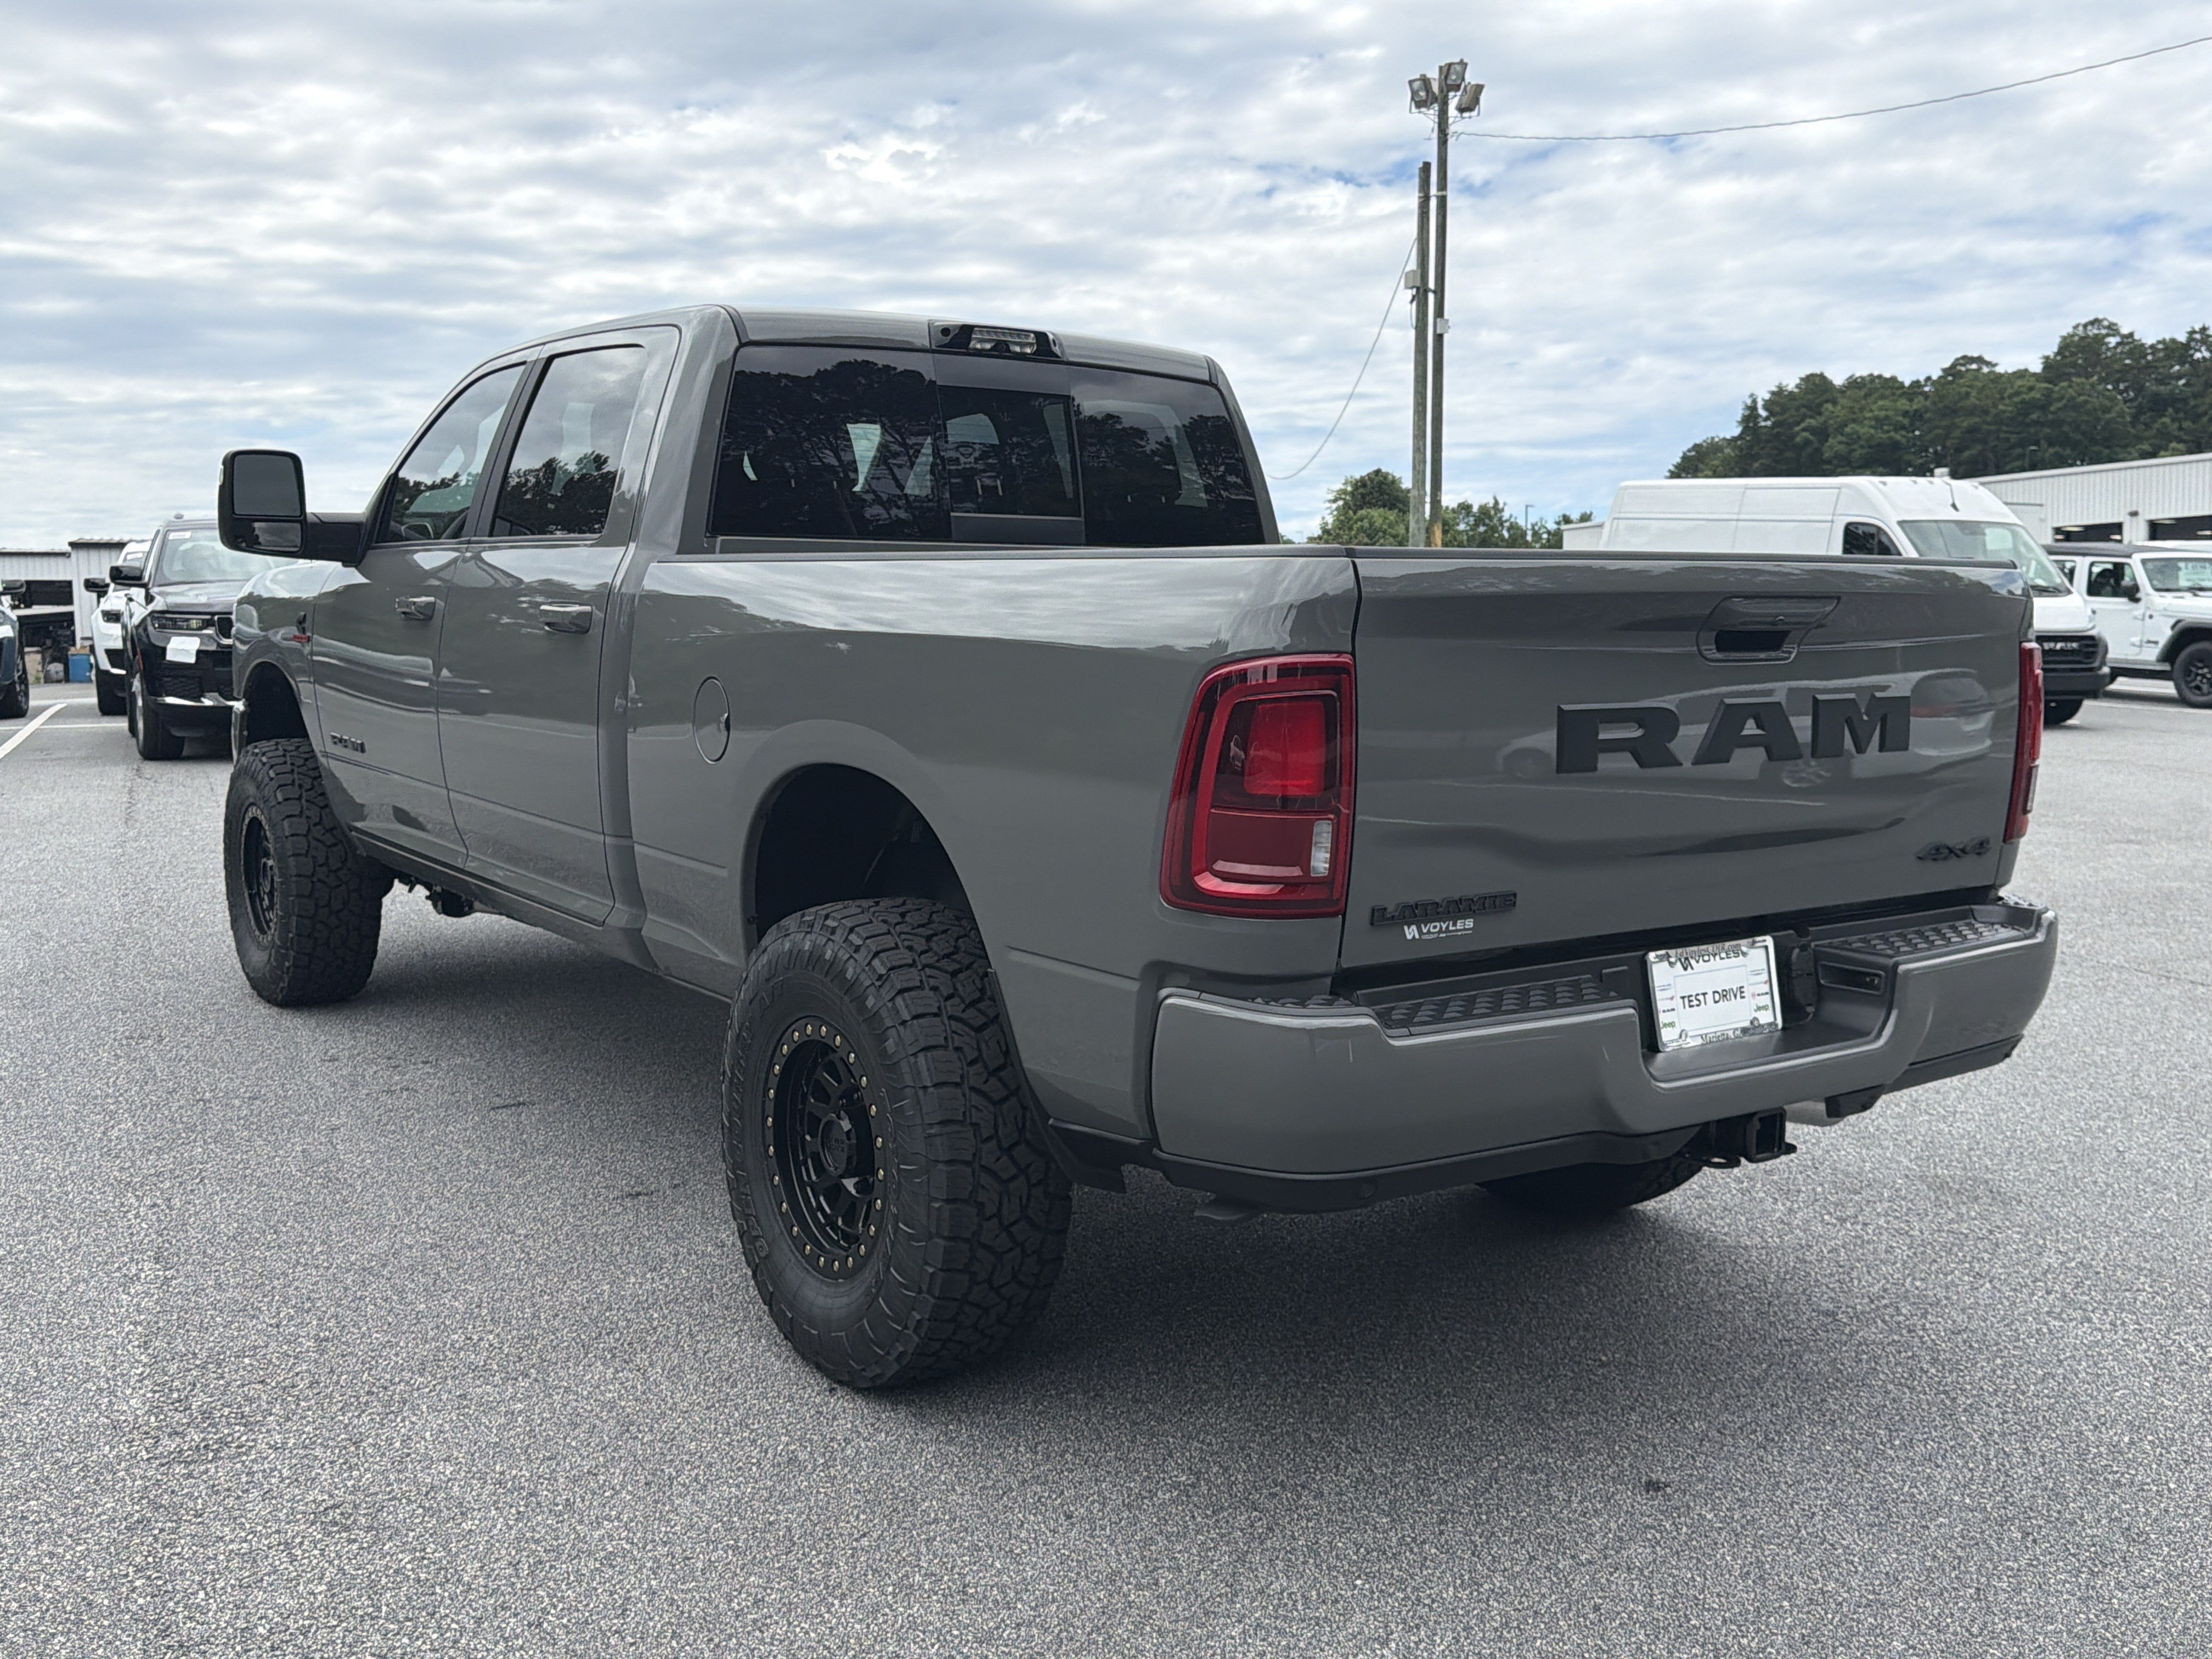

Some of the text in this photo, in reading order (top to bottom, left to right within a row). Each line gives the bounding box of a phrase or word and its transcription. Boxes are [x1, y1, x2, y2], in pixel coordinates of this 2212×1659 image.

[1556, 692, 1911, 774] RAM
[1370, 890, 1517, 926] LARAMIE
[1421, 918, 1474, 933] VOYLES
[1692, 950, 1741, 964] VOYLES
[1679, 985, 1746, 1009] TEST DRIVE
[1754, 1003, 1770, 1013] Jeep
[1660, 1020, 1676, 1029] Jeep
